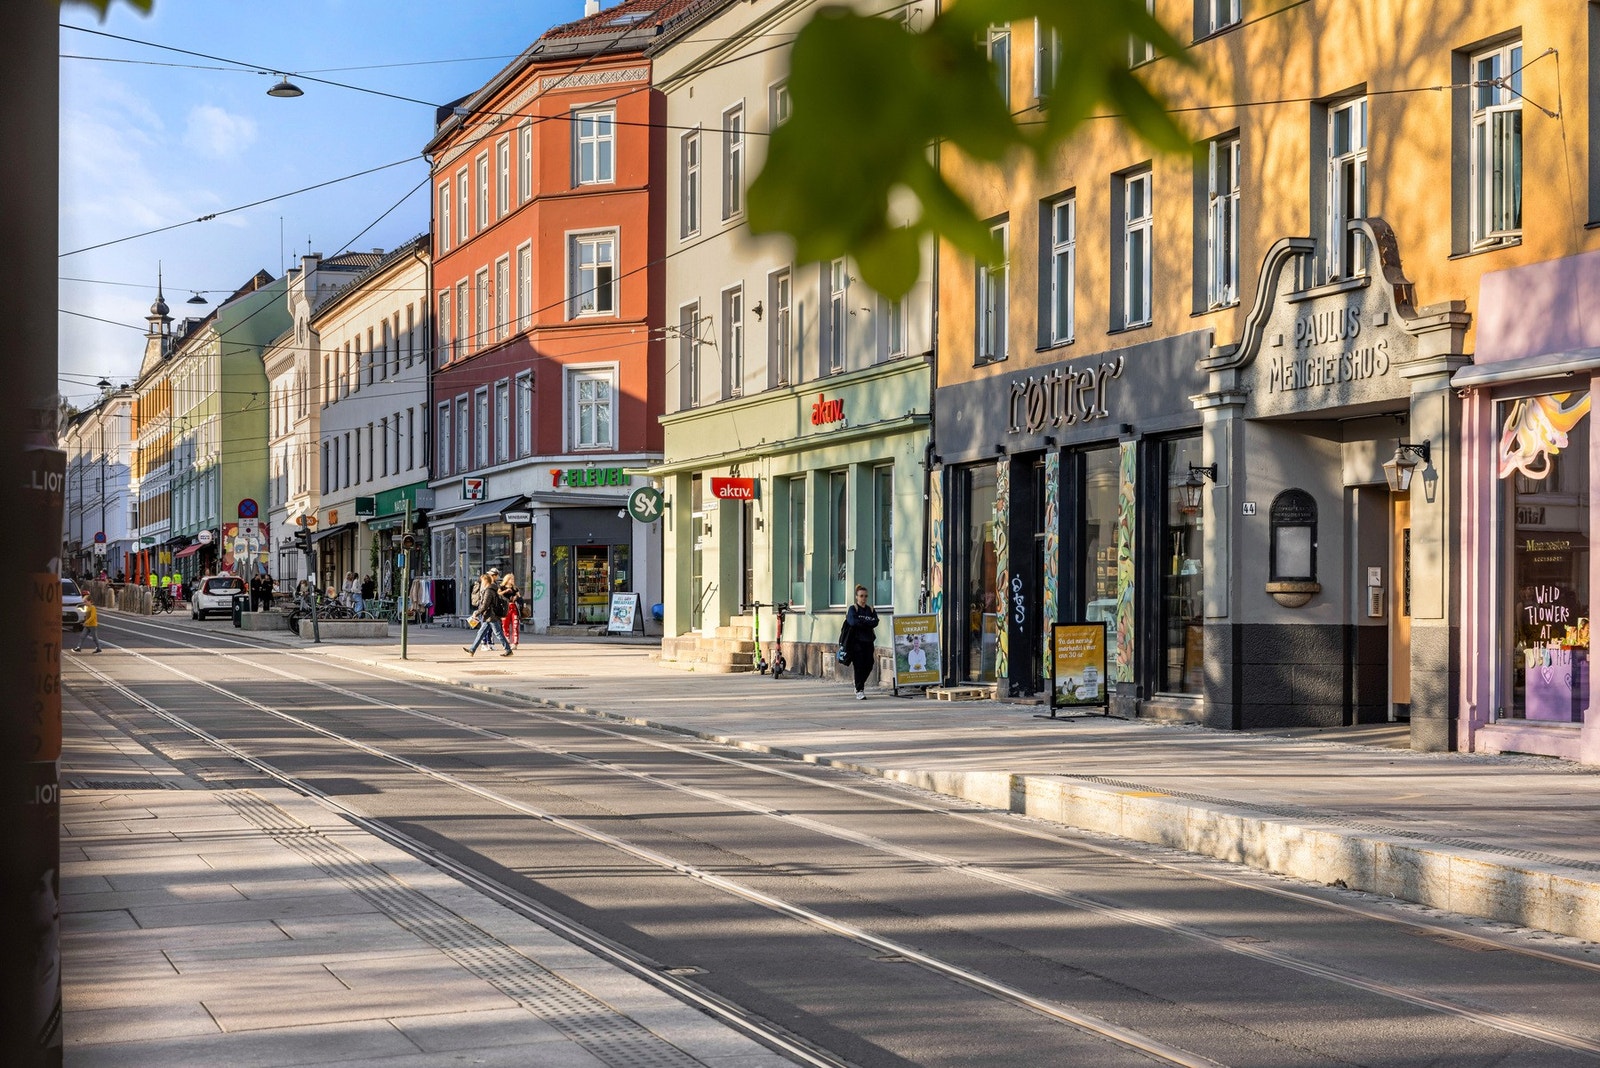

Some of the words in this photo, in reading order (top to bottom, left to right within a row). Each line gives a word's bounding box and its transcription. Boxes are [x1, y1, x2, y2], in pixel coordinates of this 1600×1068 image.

[1295, 306, 1360, 349] PAULUS
[1007, 355, 1124, 435] røtter
[22, 470, 63, 493] LIOT
[1243, 503, 1254, 514] 44
[1524, 605, 1570, 625] FLOWERS
[1540, 624, 1552, 639] AT
